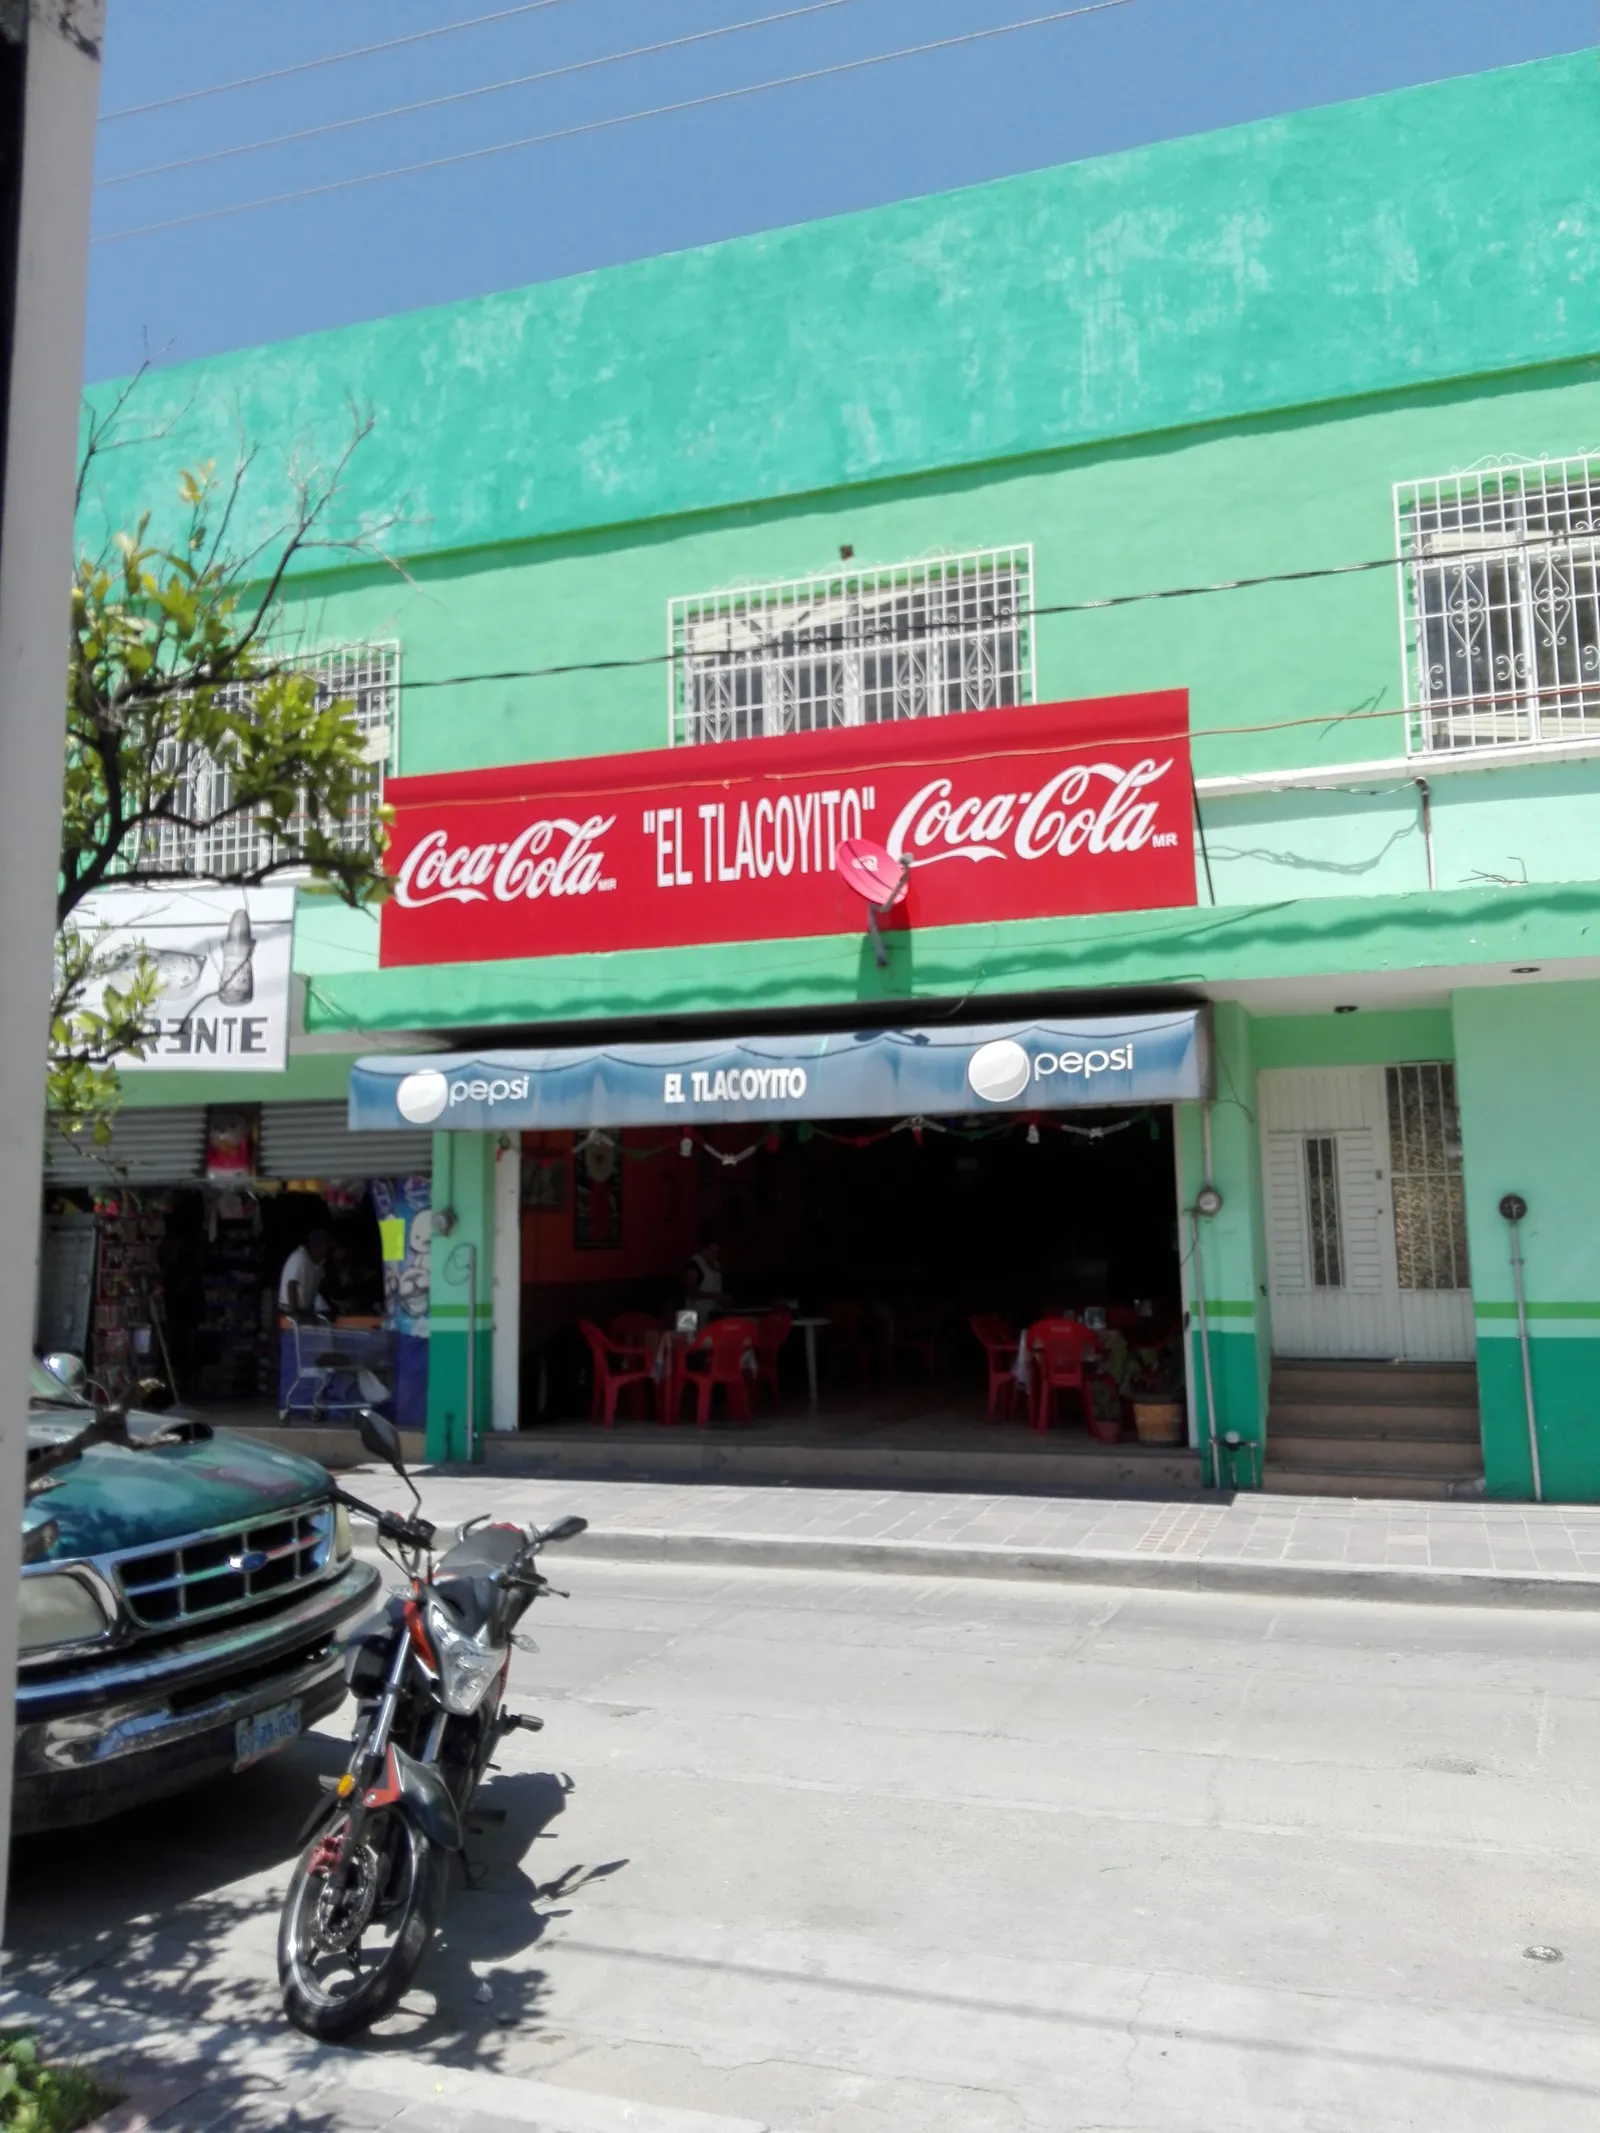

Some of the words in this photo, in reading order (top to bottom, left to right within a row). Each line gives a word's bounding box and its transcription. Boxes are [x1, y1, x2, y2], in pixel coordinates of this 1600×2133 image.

[886, 757, 1174, 868] Coca-Cola
[1152, 832, 1178, 848] MR
[394, 814, 617, 908] Coca-Cola
[1033, 1043, 1134, 1081] pepsi
[448, 1075, 530, 1107] pepsi
[664, 1072, 686, 1103] EL
[691, 1066, 807, 1102] TLACOYITO
